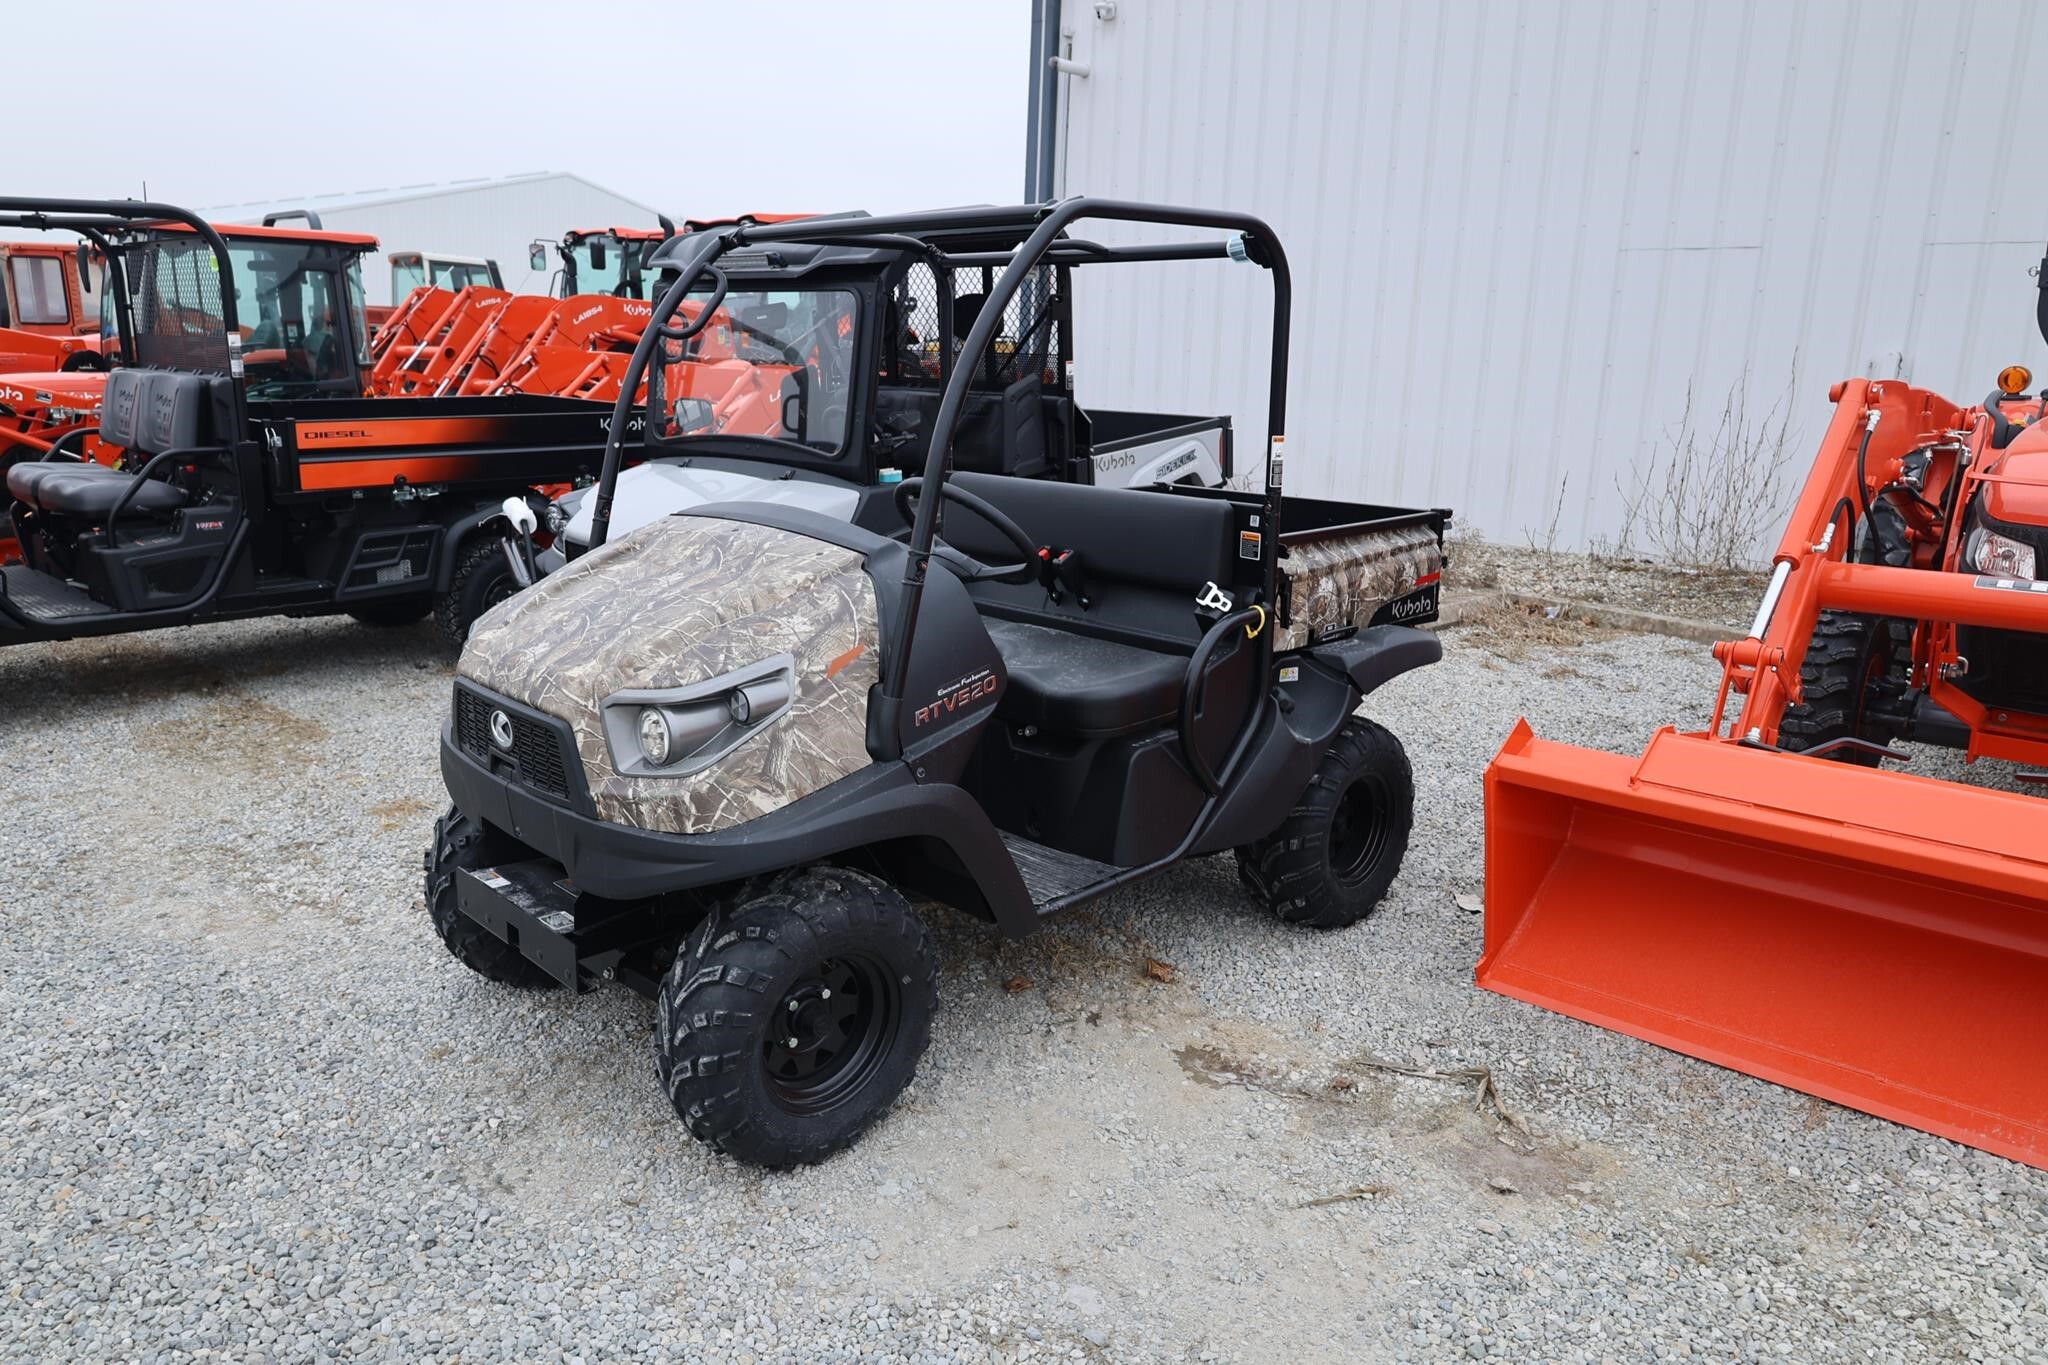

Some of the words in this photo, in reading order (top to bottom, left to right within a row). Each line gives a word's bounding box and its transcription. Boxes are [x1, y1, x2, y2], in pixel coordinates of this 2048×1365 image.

[623, 304, 652, 316] Kubo
[304, 430, 373, 440] DIESEL
[1095, 452, 1136, 472] Kubota
[1392, 596, 1432, 618] Kubota
[915, 675, 997, 727] RTV520
